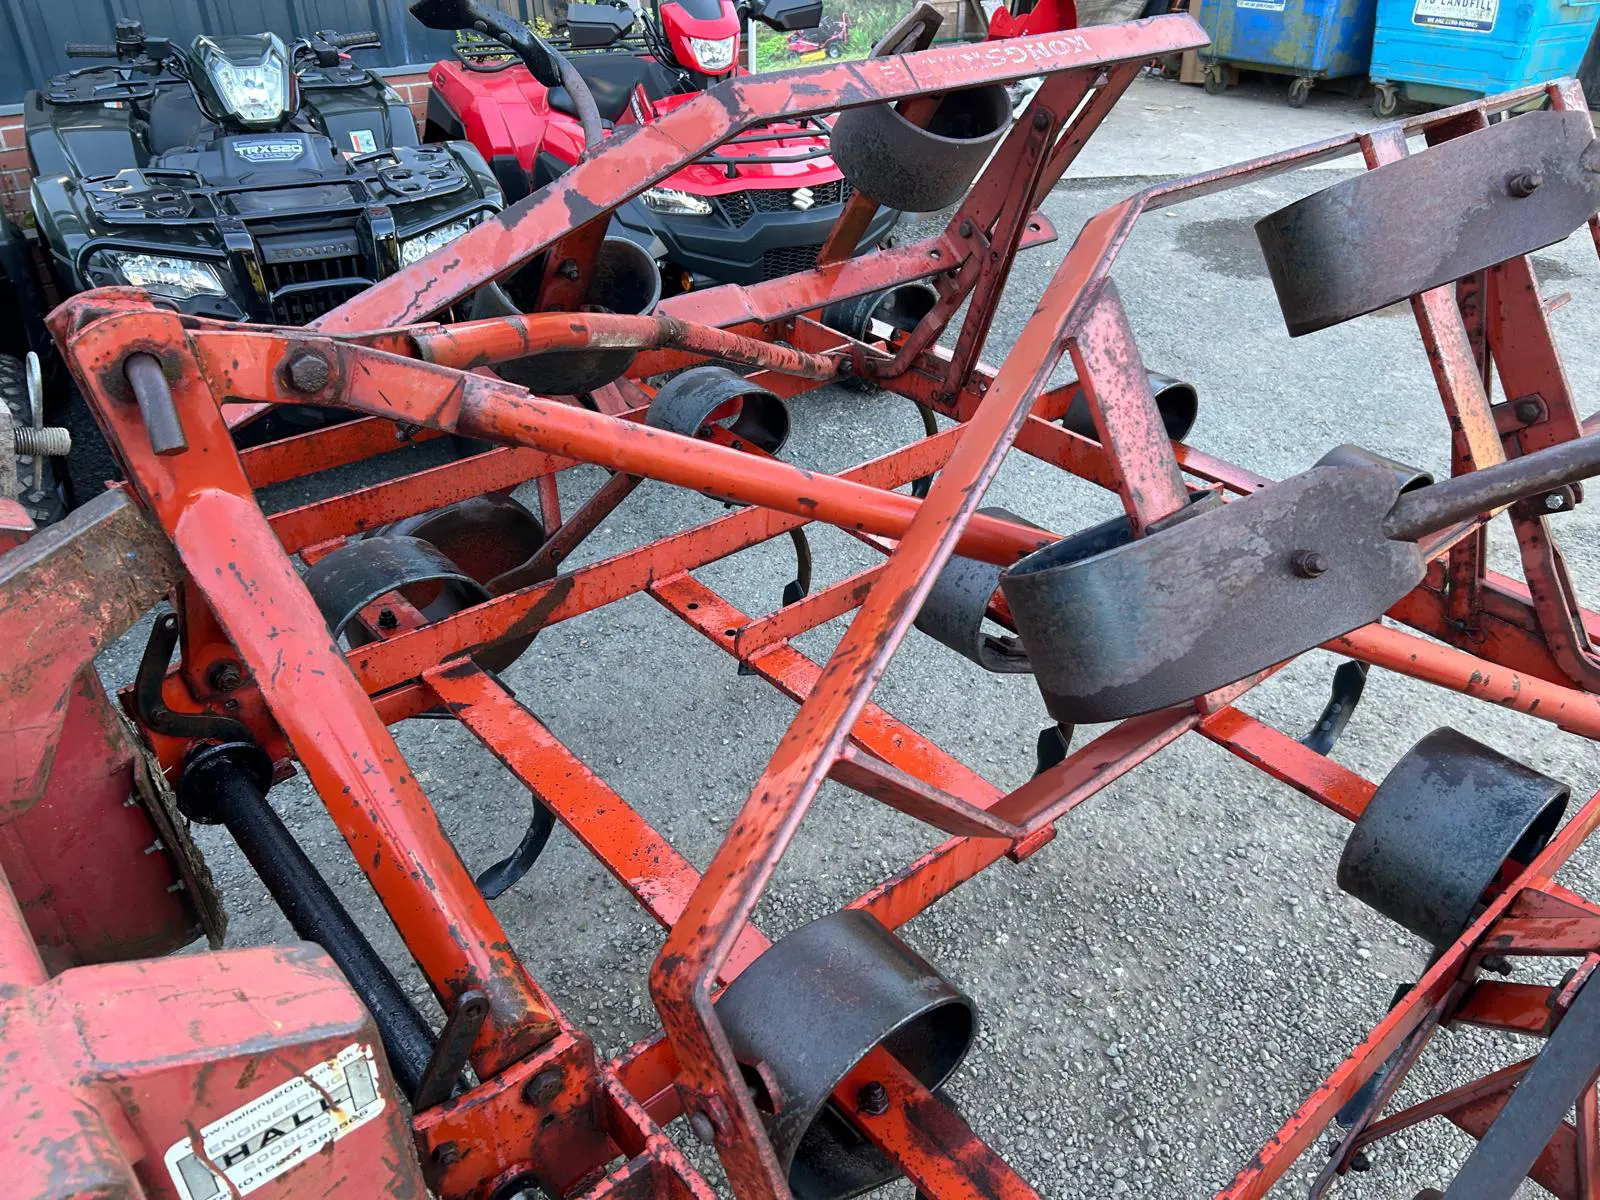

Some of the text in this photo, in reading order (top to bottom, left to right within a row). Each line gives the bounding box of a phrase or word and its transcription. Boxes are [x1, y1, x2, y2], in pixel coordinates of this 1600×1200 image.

[1441, 0, 1491, 11] LANDFILL
[234, 144, 303, 155] TRX520
[272, 242, 353, 259] HONDA
[208, 1073, 343, 1154] ENGINEERING
[223, 1098, 341, 1168] HALL
